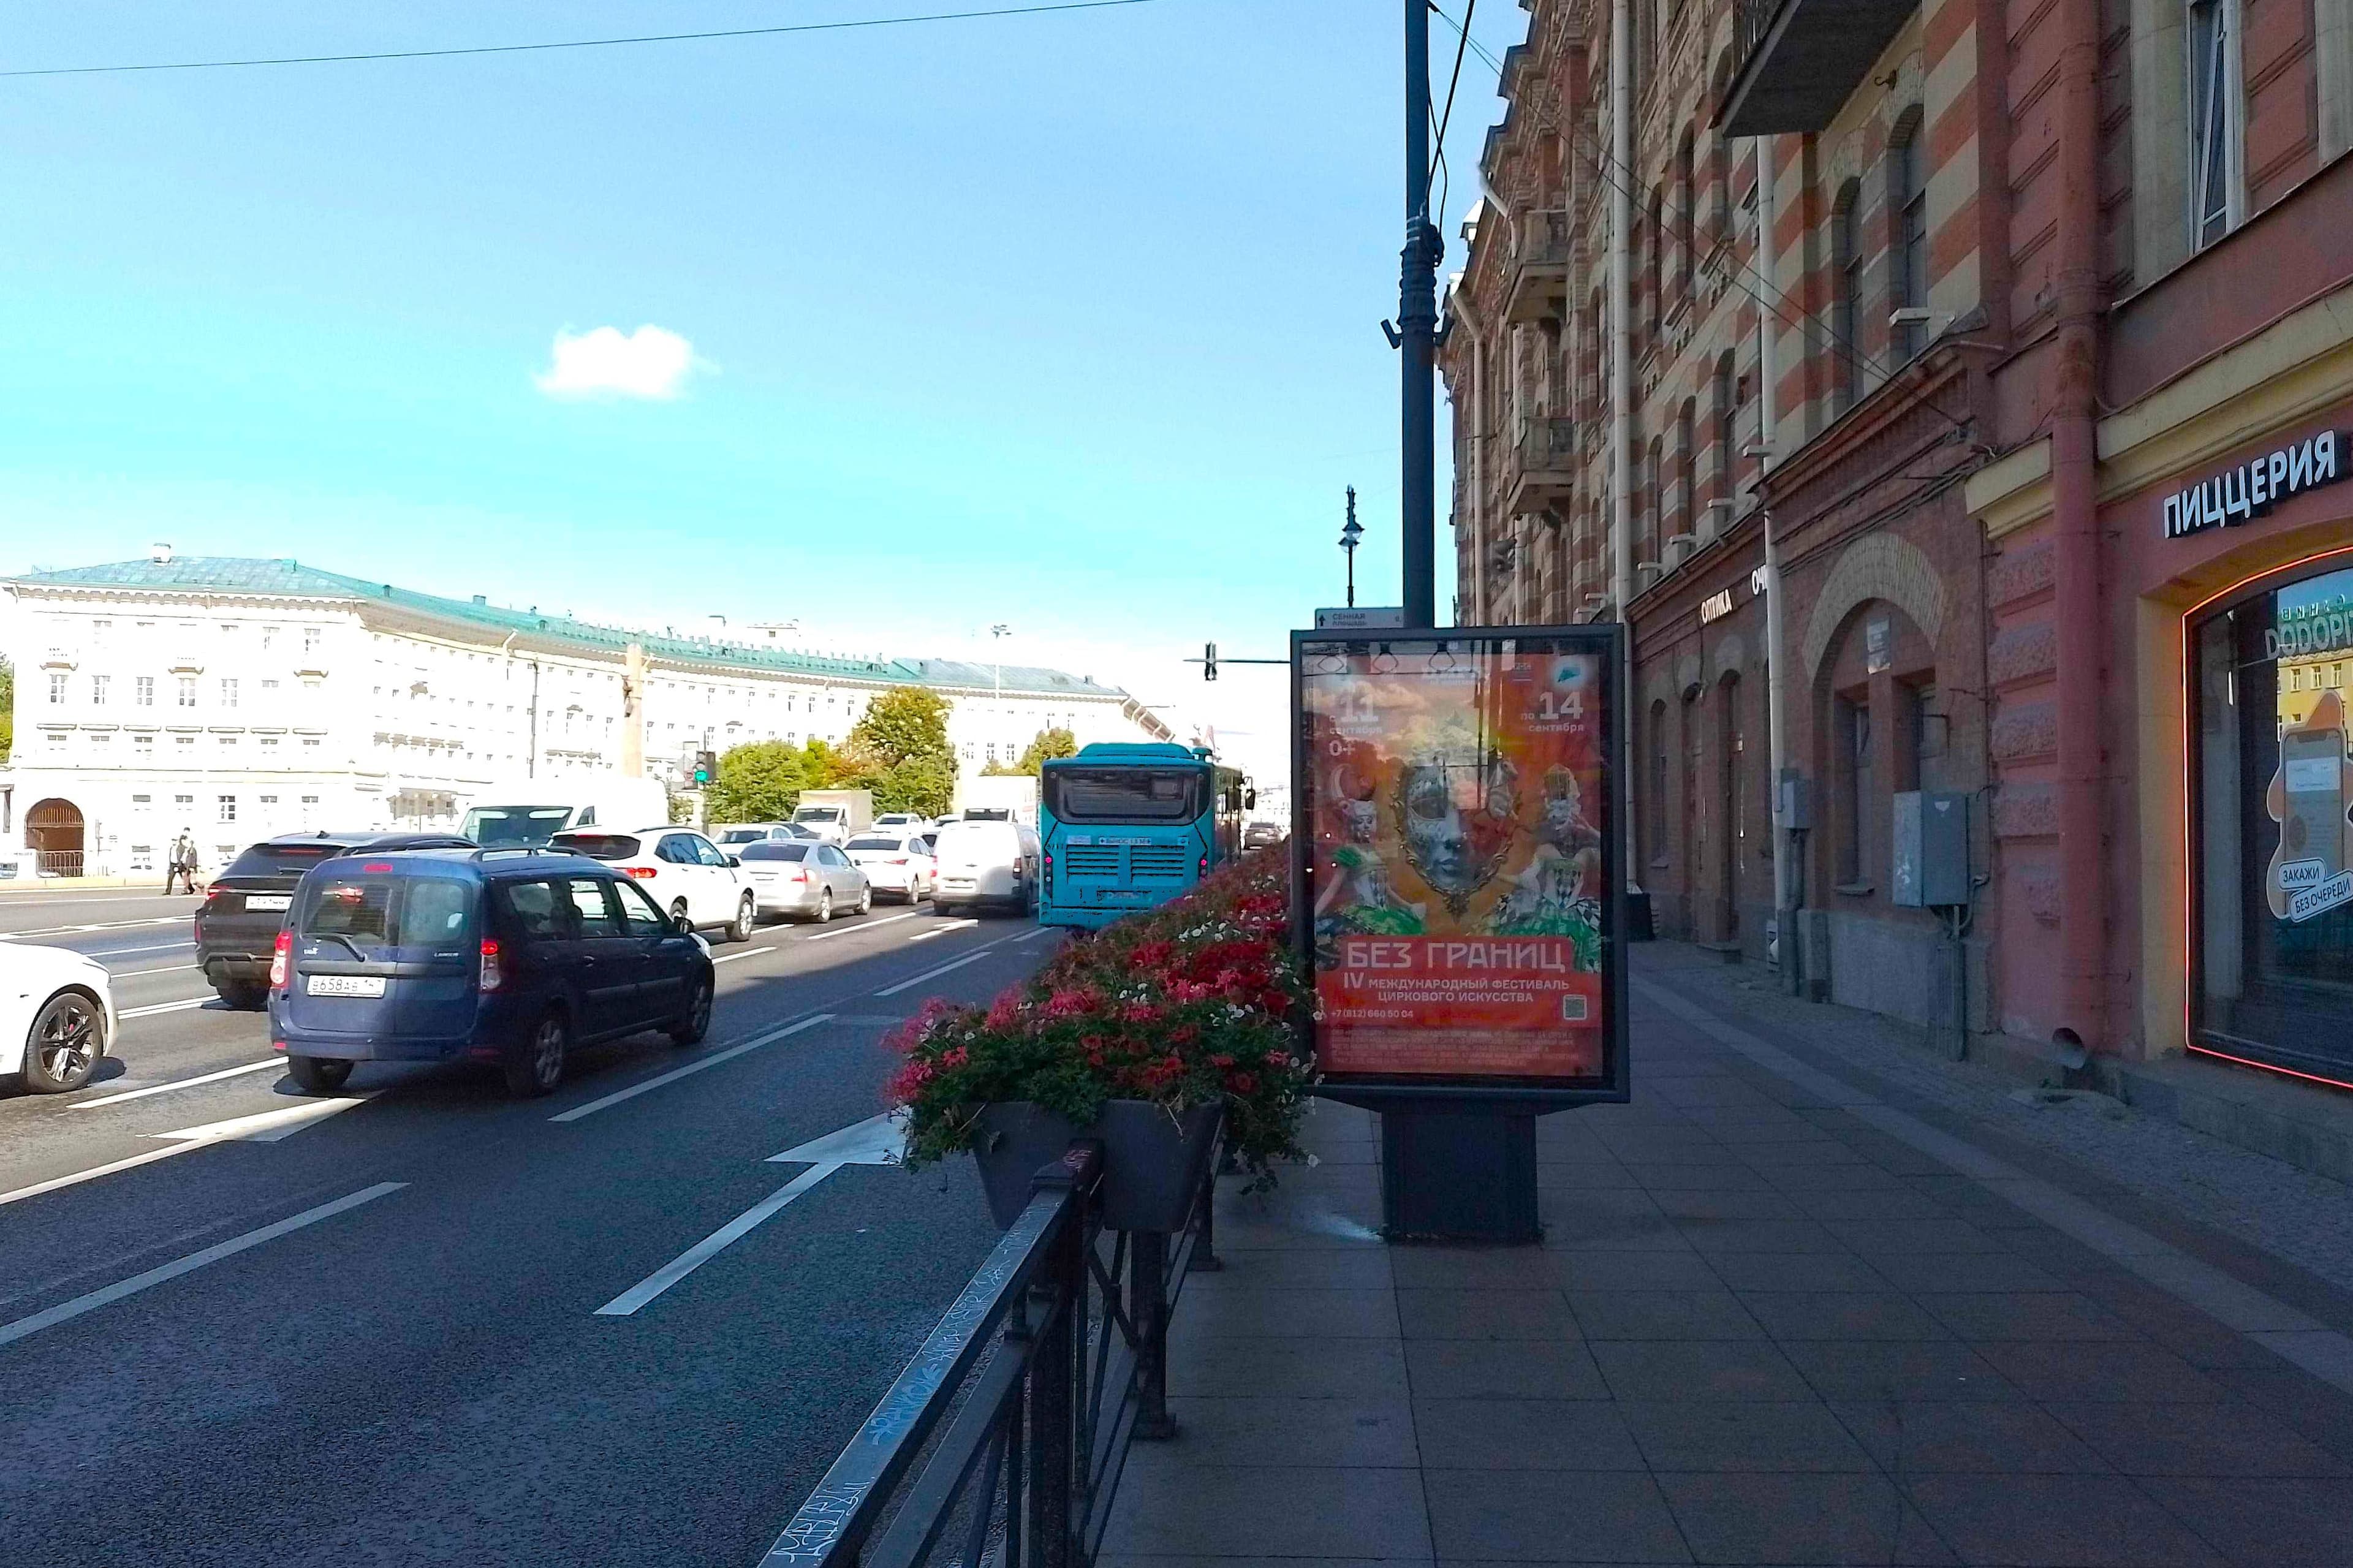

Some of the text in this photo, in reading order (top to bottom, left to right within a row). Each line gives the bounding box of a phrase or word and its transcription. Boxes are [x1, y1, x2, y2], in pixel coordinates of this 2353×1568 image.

[2164, 430, 2336, 538] ПИЦЦЕРИЯ
[1701, 564, 1767, 624] ОПТИКА ОЧ
[1339, 693, 1378, 722] 11
[1539, 691, 1583, 720] 14
[1528, 722, 1585, 733] сентября
[1328, 740, 1355, 757] 0+
[2283, 866, 2320, 883] ЗАКАЖИ
[2295, 878, 2351, 914] БЕЗ ОЧЕРЕДИ
[1347, 942, 1566, 973] БЕЗ ГРАНИЦ
[1344, 972, 1570, 991] IV МЕЖДУНАРОДНЫЙ ФЕСТИВАЛЬ
[1378, 991, 1534, 1003] ЦИРКОВОГО ИСКУССТВА
